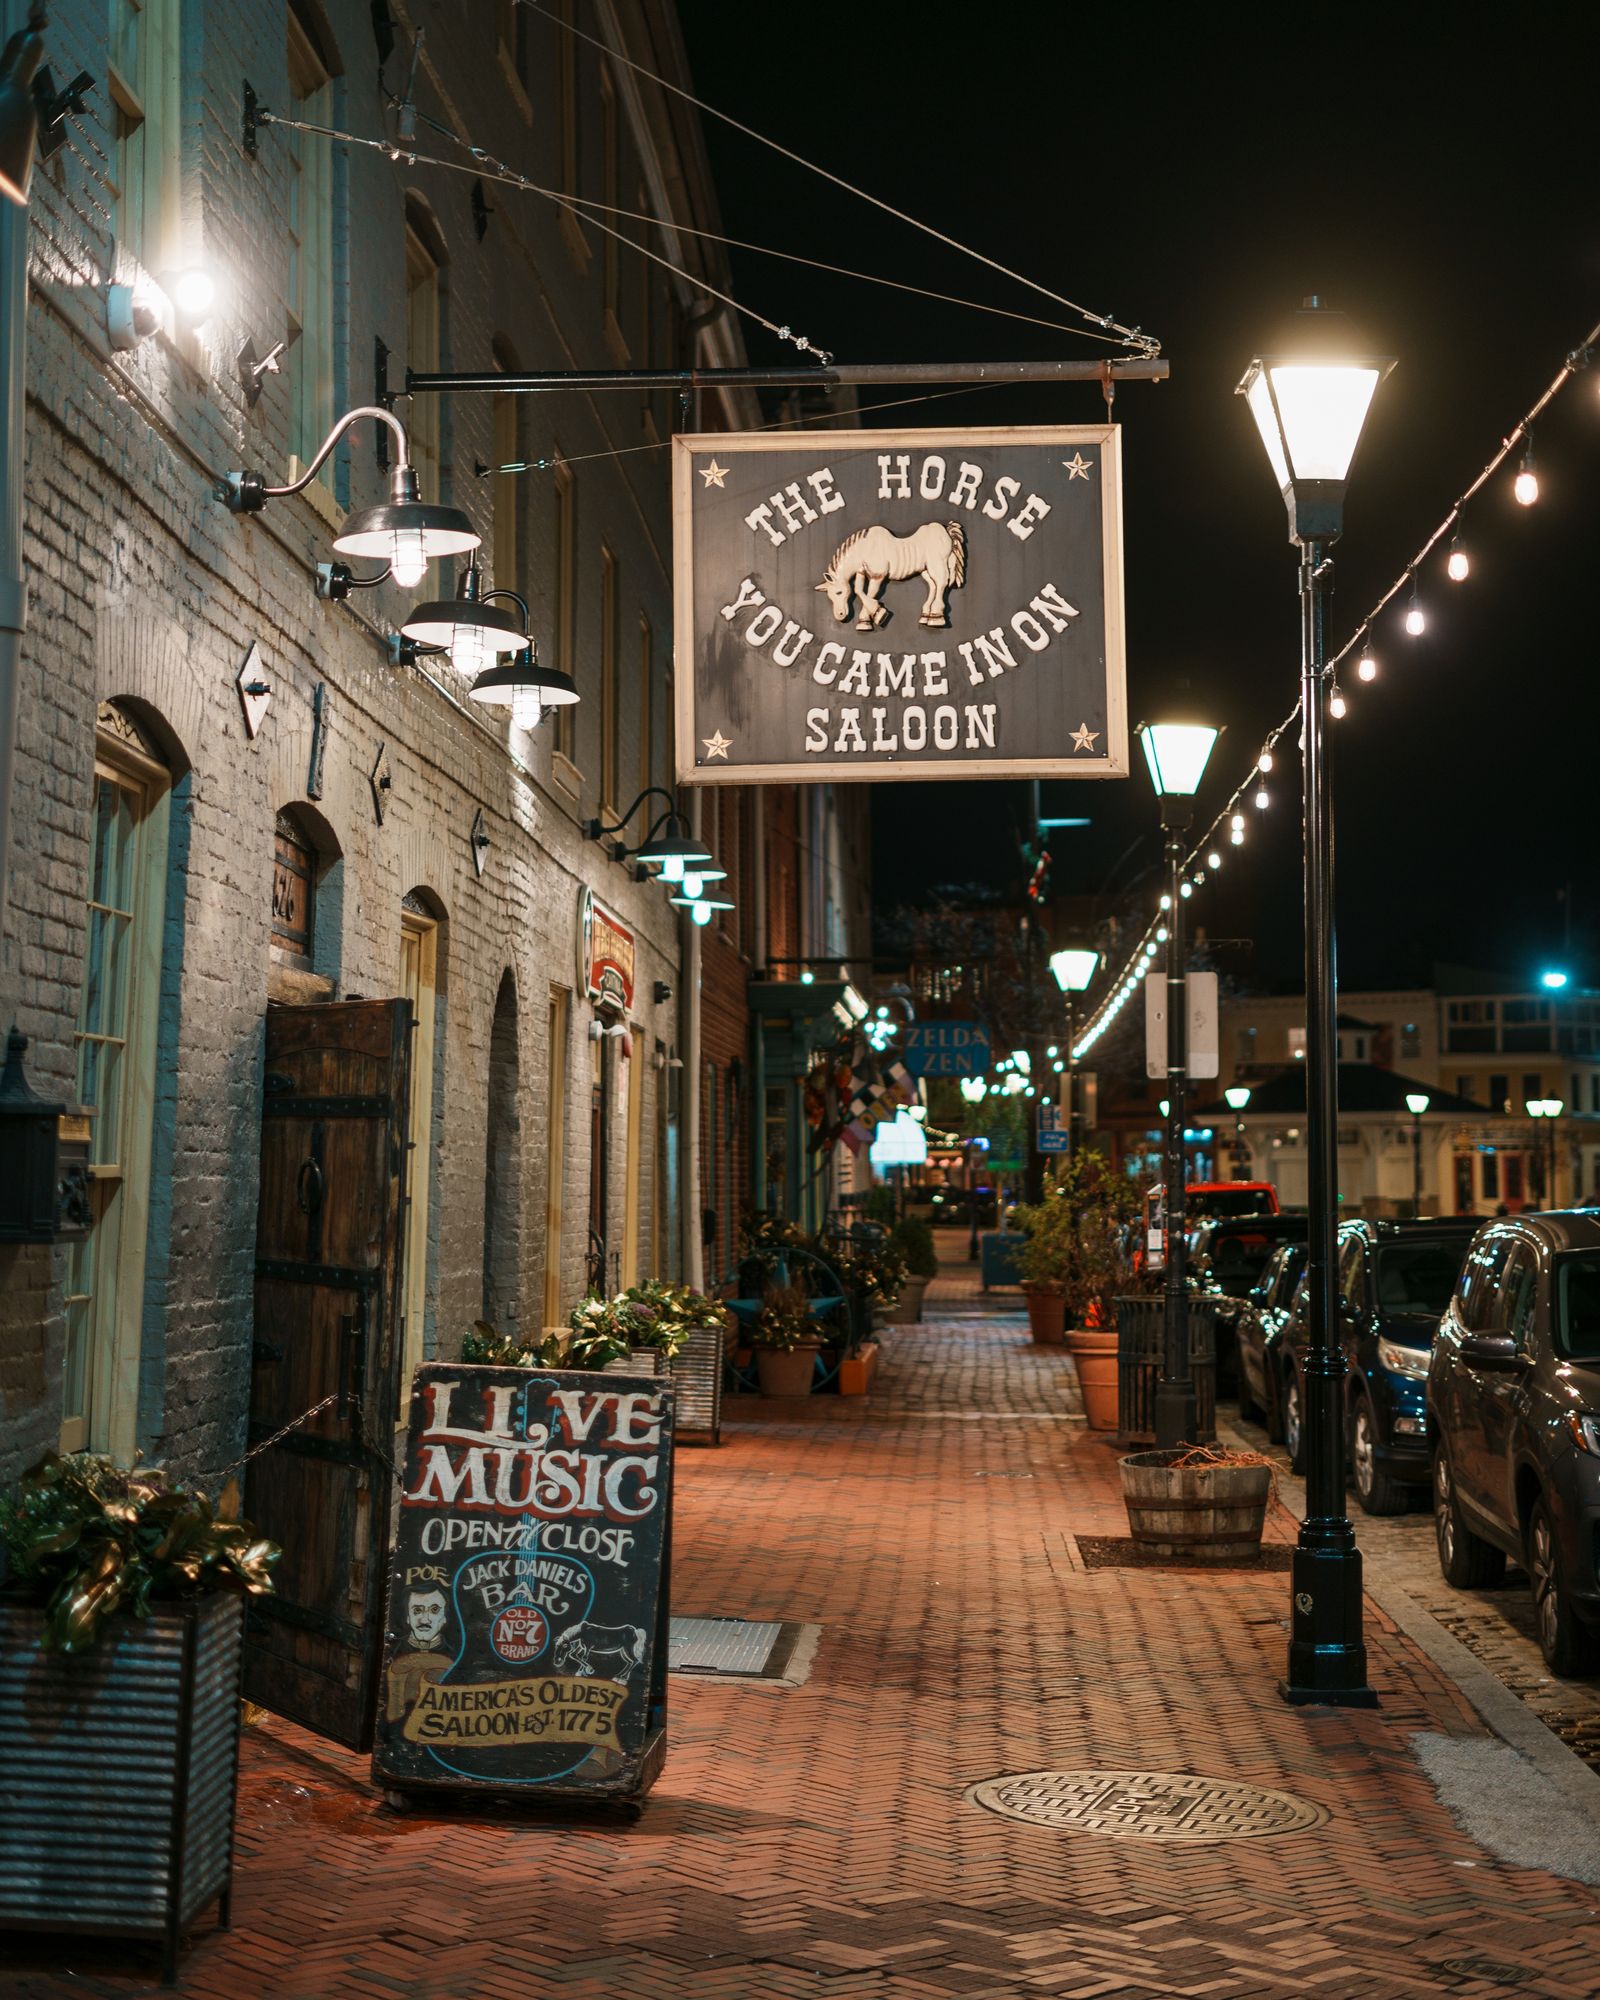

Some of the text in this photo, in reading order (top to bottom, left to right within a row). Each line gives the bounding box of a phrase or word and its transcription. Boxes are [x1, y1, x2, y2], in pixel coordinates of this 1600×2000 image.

[744, 454, 1052, 547] THE HORSE
[721, 578, 1080, 698] YOU CAME IN ON
[805, 704, 998, 753] SALOON
[905, 1027, 989, 1047] ZELDA
[923, 1053, 972, 1072] ZEN
[420, 1381, 666, 1449] LIVE
[407, 1445, 660, 1516] MUSIC
[421, 1517, 503, 1555] OPEN
[542, 1524, 635, 1568] CLOSE
[463, 1560, 588, 1594] JACK DANIELS
[481, 1581, 570, 1615] BAR
[506, 1608, 538, 1619] OLD
[500, 1645, 540, 1659] BRAND
[418, 1680, 624, 1712] AMERICA'S OLDEST
[418, 1712, 520, 1737] SALOON
[557, 1709, 612, 1735] 1775
